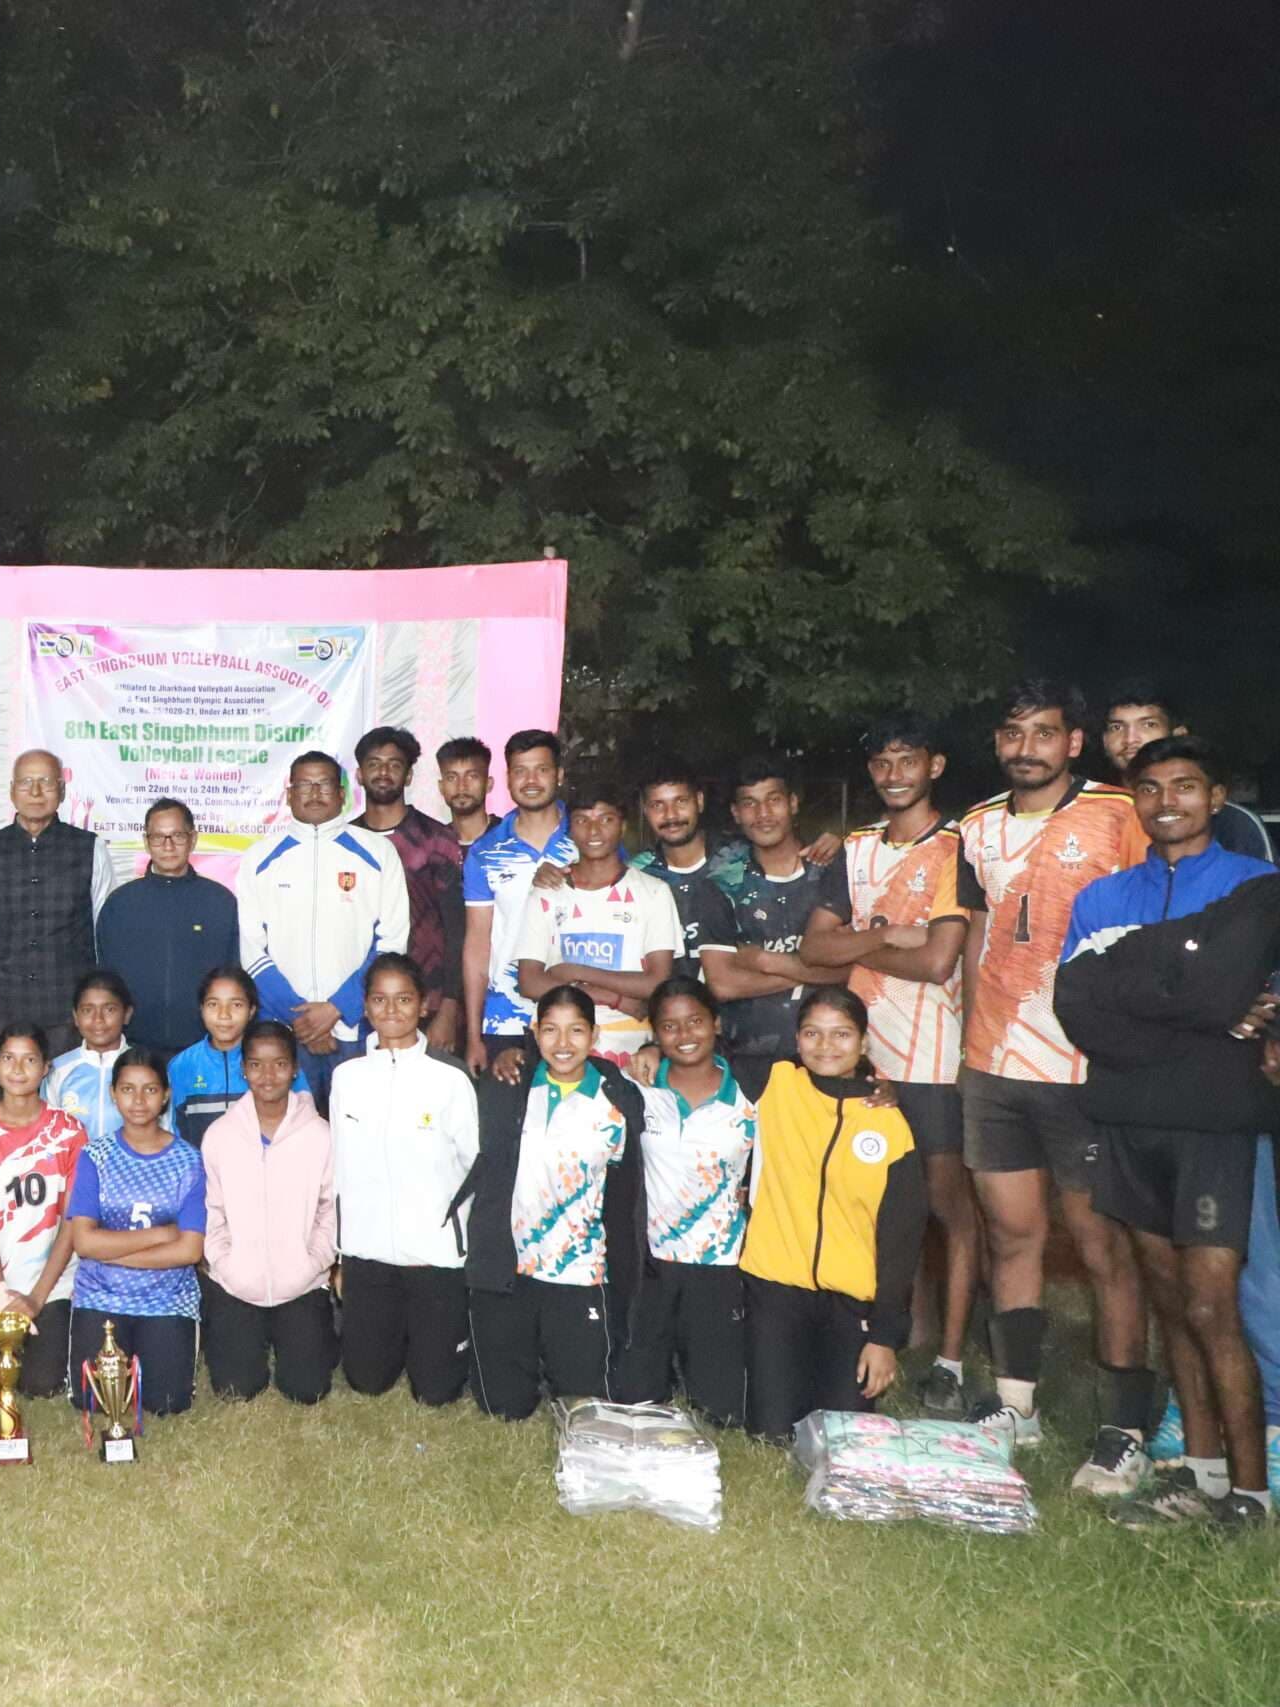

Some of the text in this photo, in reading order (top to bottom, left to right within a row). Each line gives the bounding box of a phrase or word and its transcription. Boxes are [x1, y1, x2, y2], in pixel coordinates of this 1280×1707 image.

[55, 668, 85, 692] EAST
[172, 651, 251, 672] VOLLEYBALL
[99, 721, 138, 740] East
[118, 744, 204, 764] Volleyball
[5, 1172, 47, 1208] 10
[129, 1201, 153, 1231] 5
